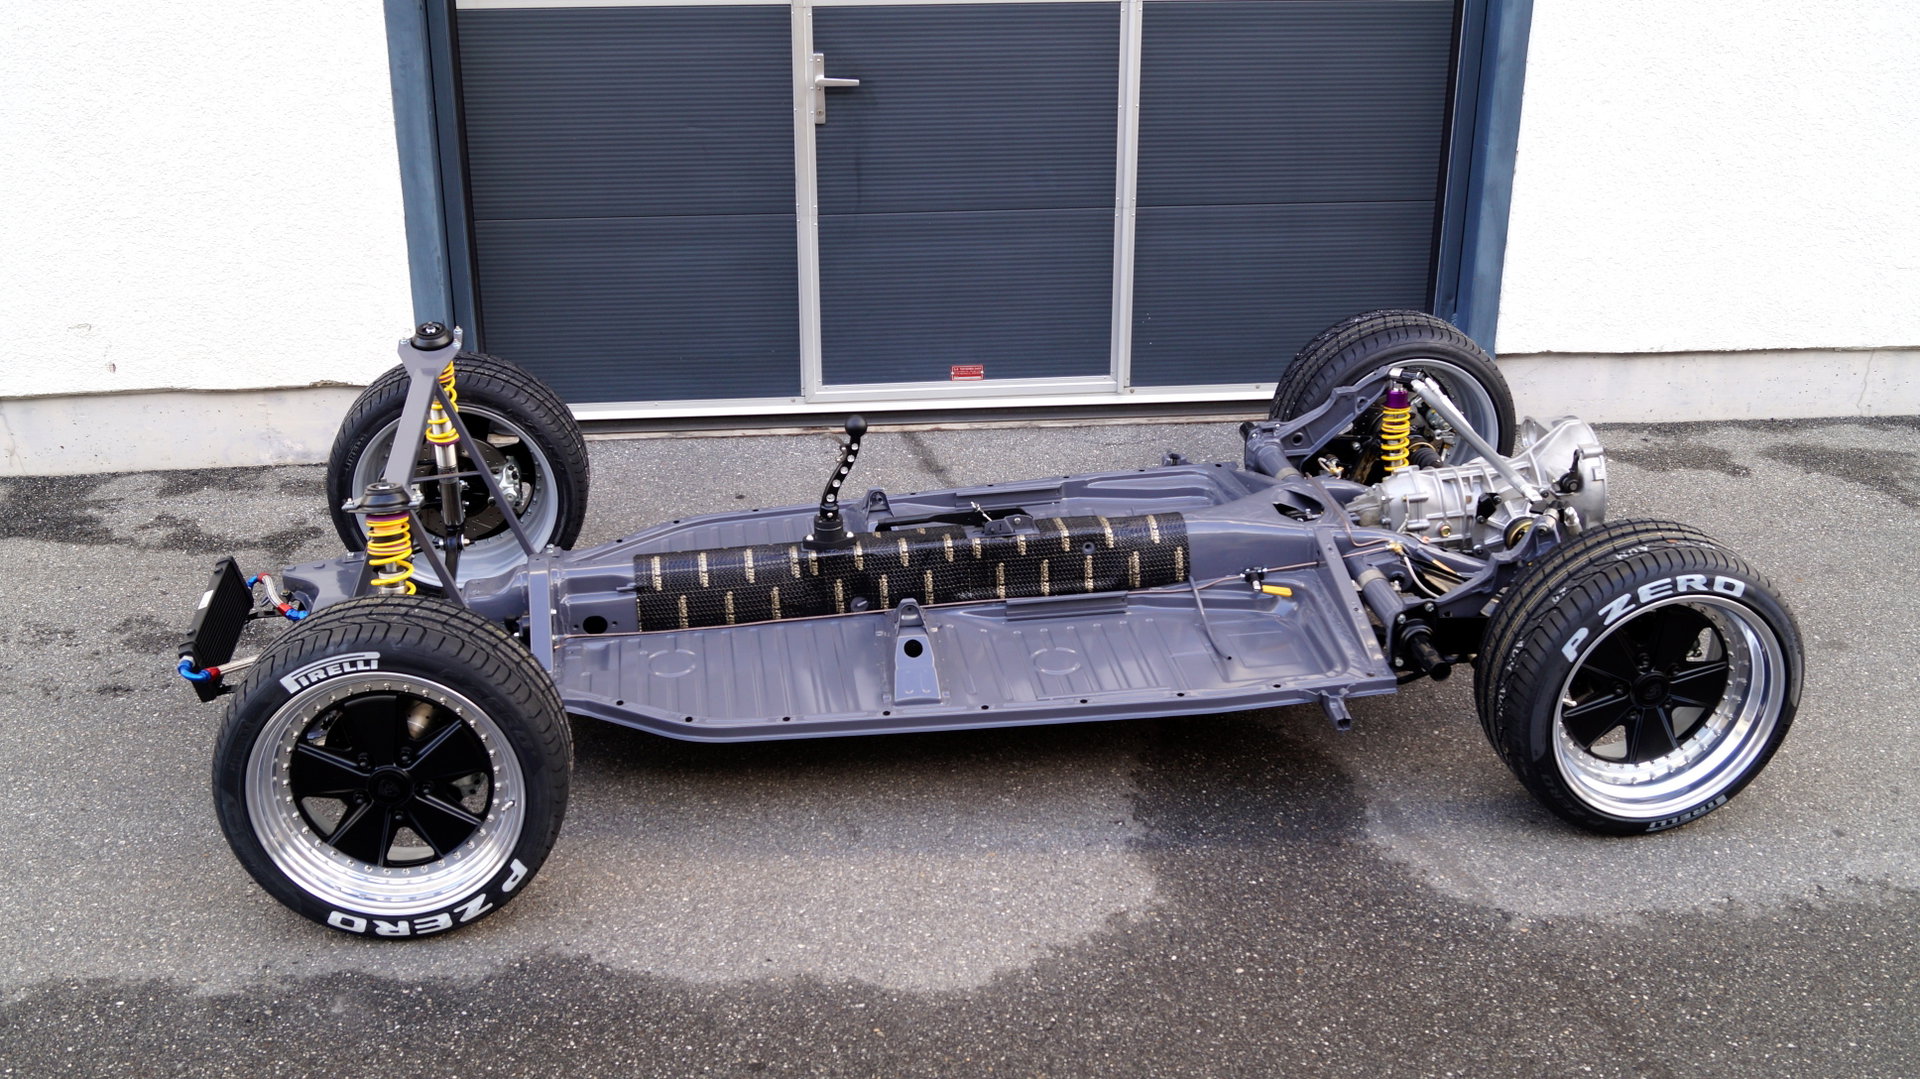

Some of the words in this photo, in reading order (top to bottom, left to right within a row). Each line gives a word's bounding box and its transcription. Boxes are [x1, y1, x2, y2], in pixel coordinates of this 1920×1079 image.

[1562, 627, 1589, 662] P
[1598, 574, 1745, 625] ZERO
[280, 651, 380, 694] PIRELLI
[501, 858, 528, 893] P
[327, 893, 493, 936] ZERO
